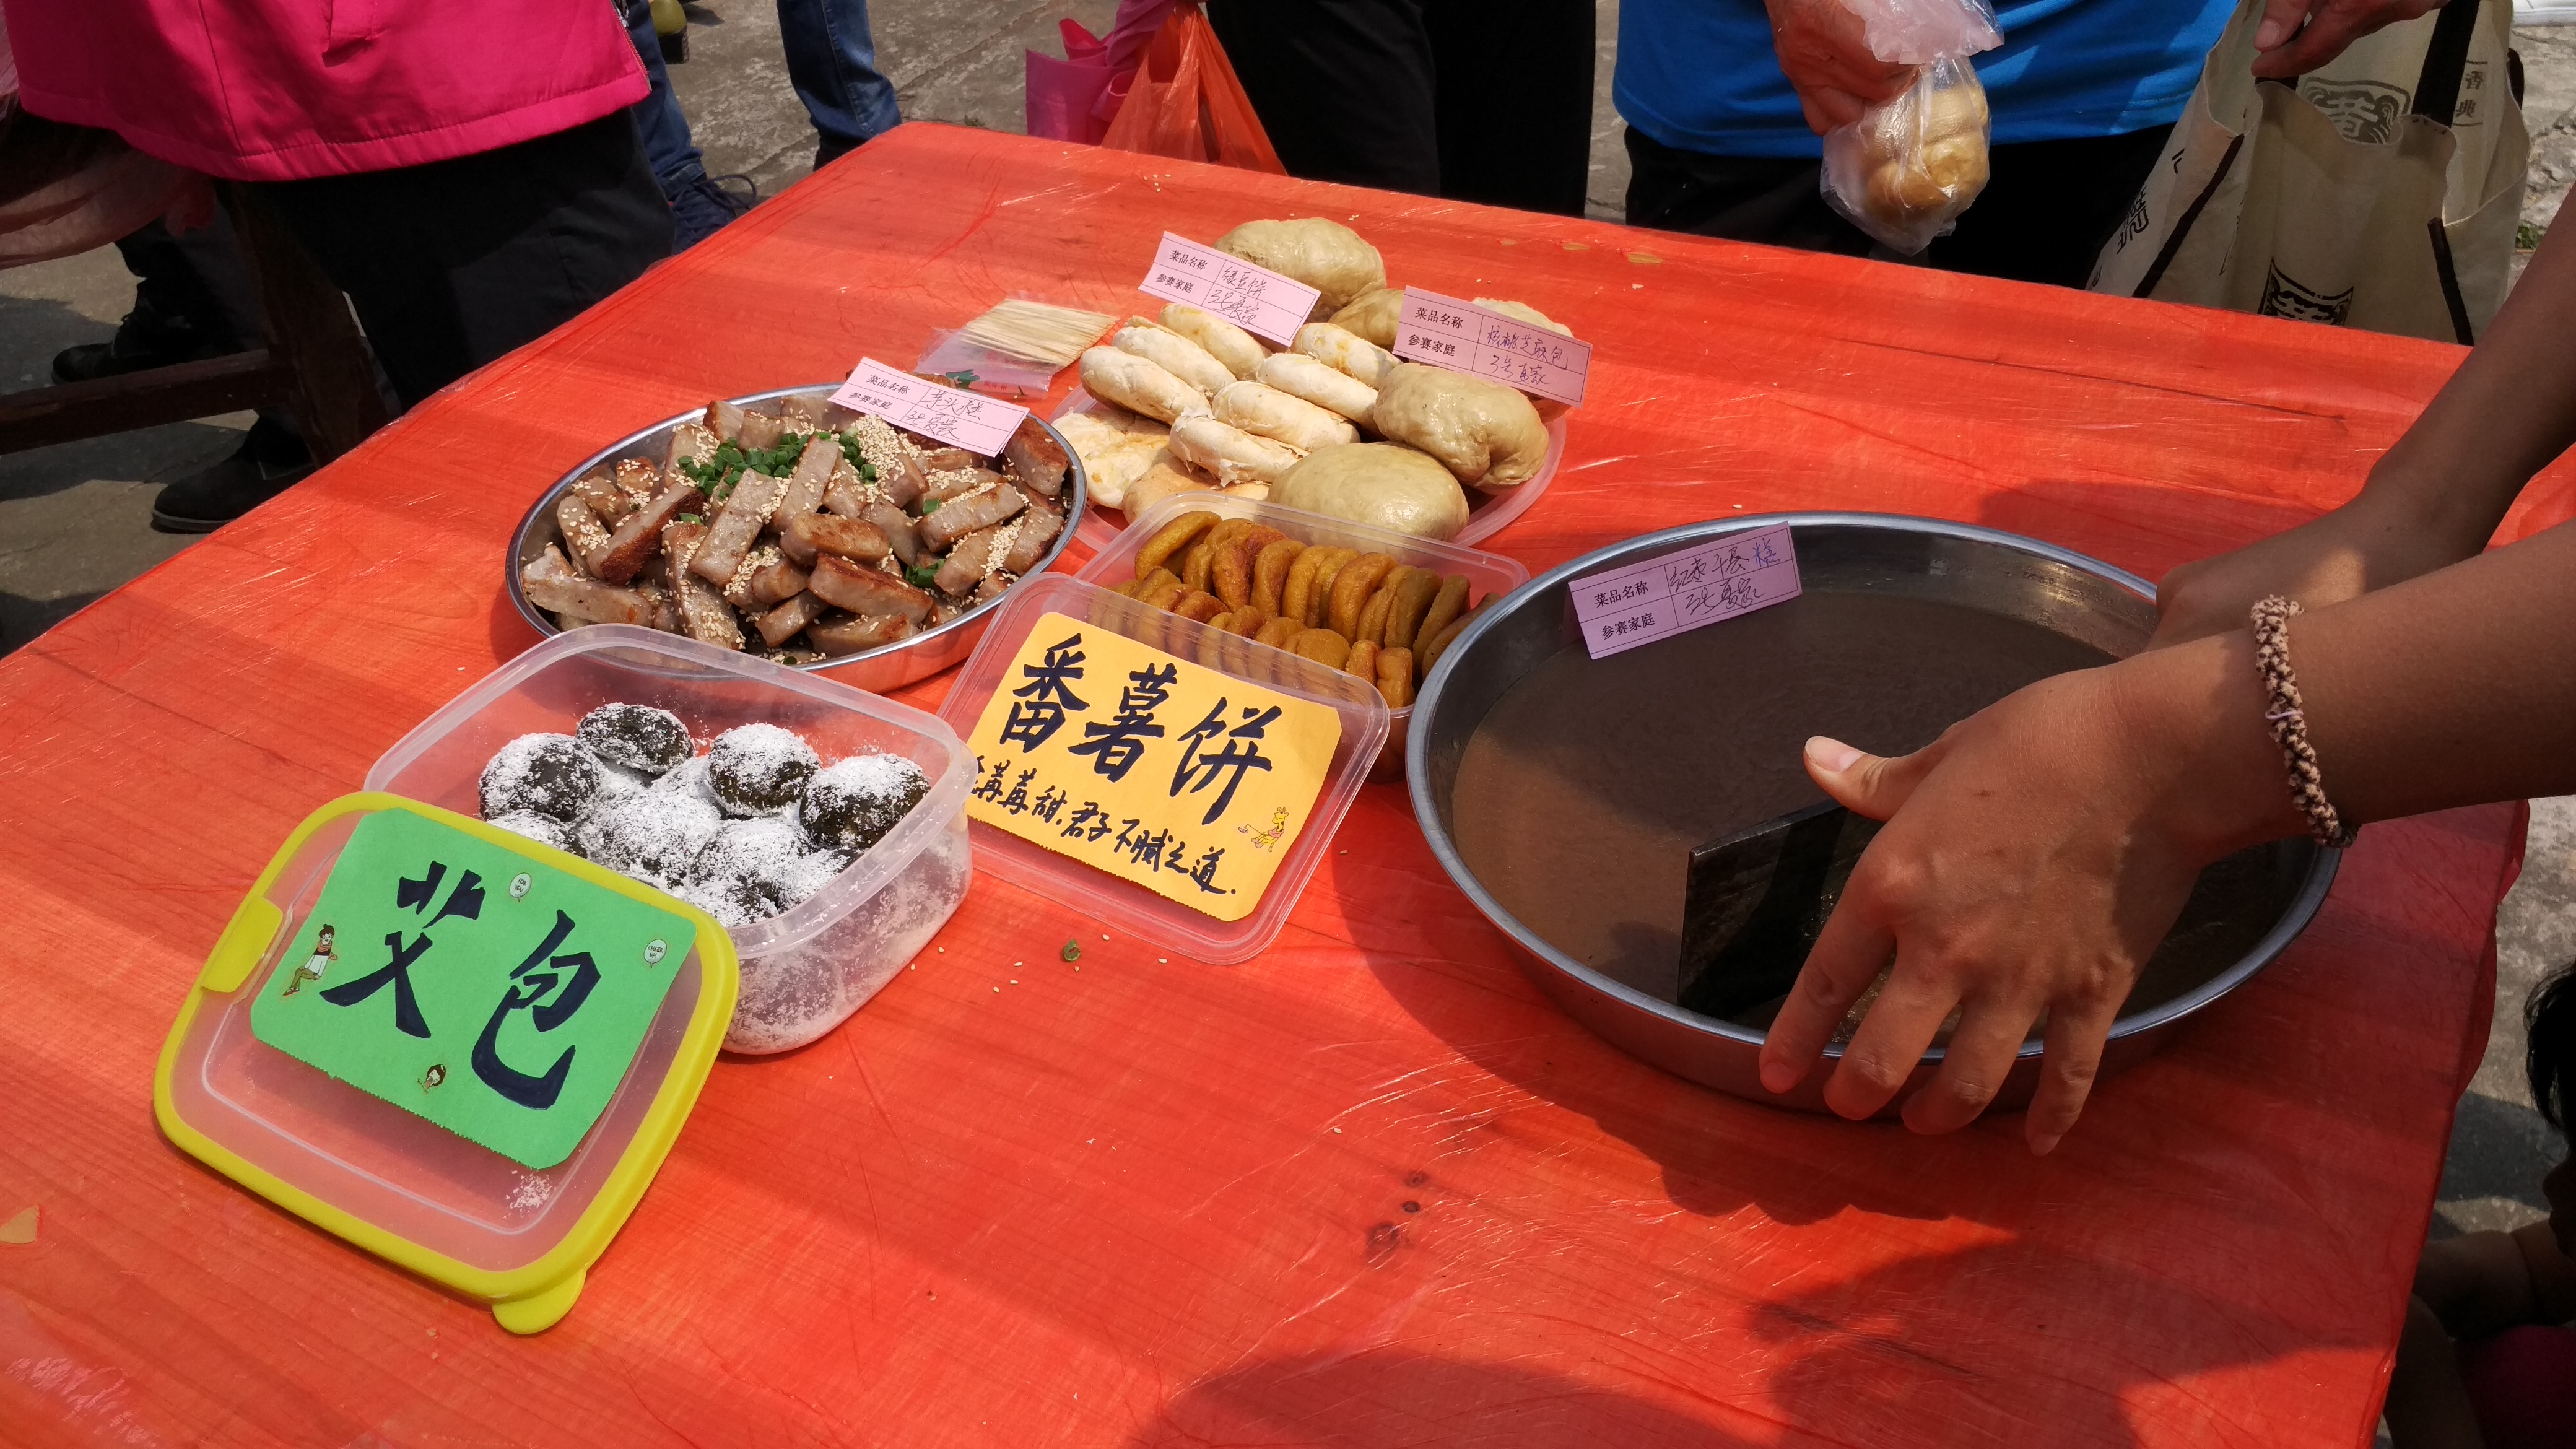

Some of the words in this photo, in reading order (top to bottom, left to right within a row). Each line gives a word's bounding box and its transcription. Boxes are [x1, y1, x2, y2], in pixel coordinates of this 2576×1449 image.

[1169, 250, 1208, 269] 菜品名称
[1156, 273, 1194, 294] 参赛家庭
[1414, 307, 1464, 329] 菜品名称
[1408, 334, 1456, 357] 参赛家庭
[866, 375, 910, 394] 菜品名称
[848, 391, 893, 411] 参赛家庭
[1595, 580, 1648, 607] 菜品名称
[1601, 612, 1655, 640] 参赛家庭
[999, 632, 1282, 825] 番薯饼
[515, 884, 524, 892] YOU
[648, 945, 663, 953] CHEER
[318, 860, 602, 1110] 艾包
